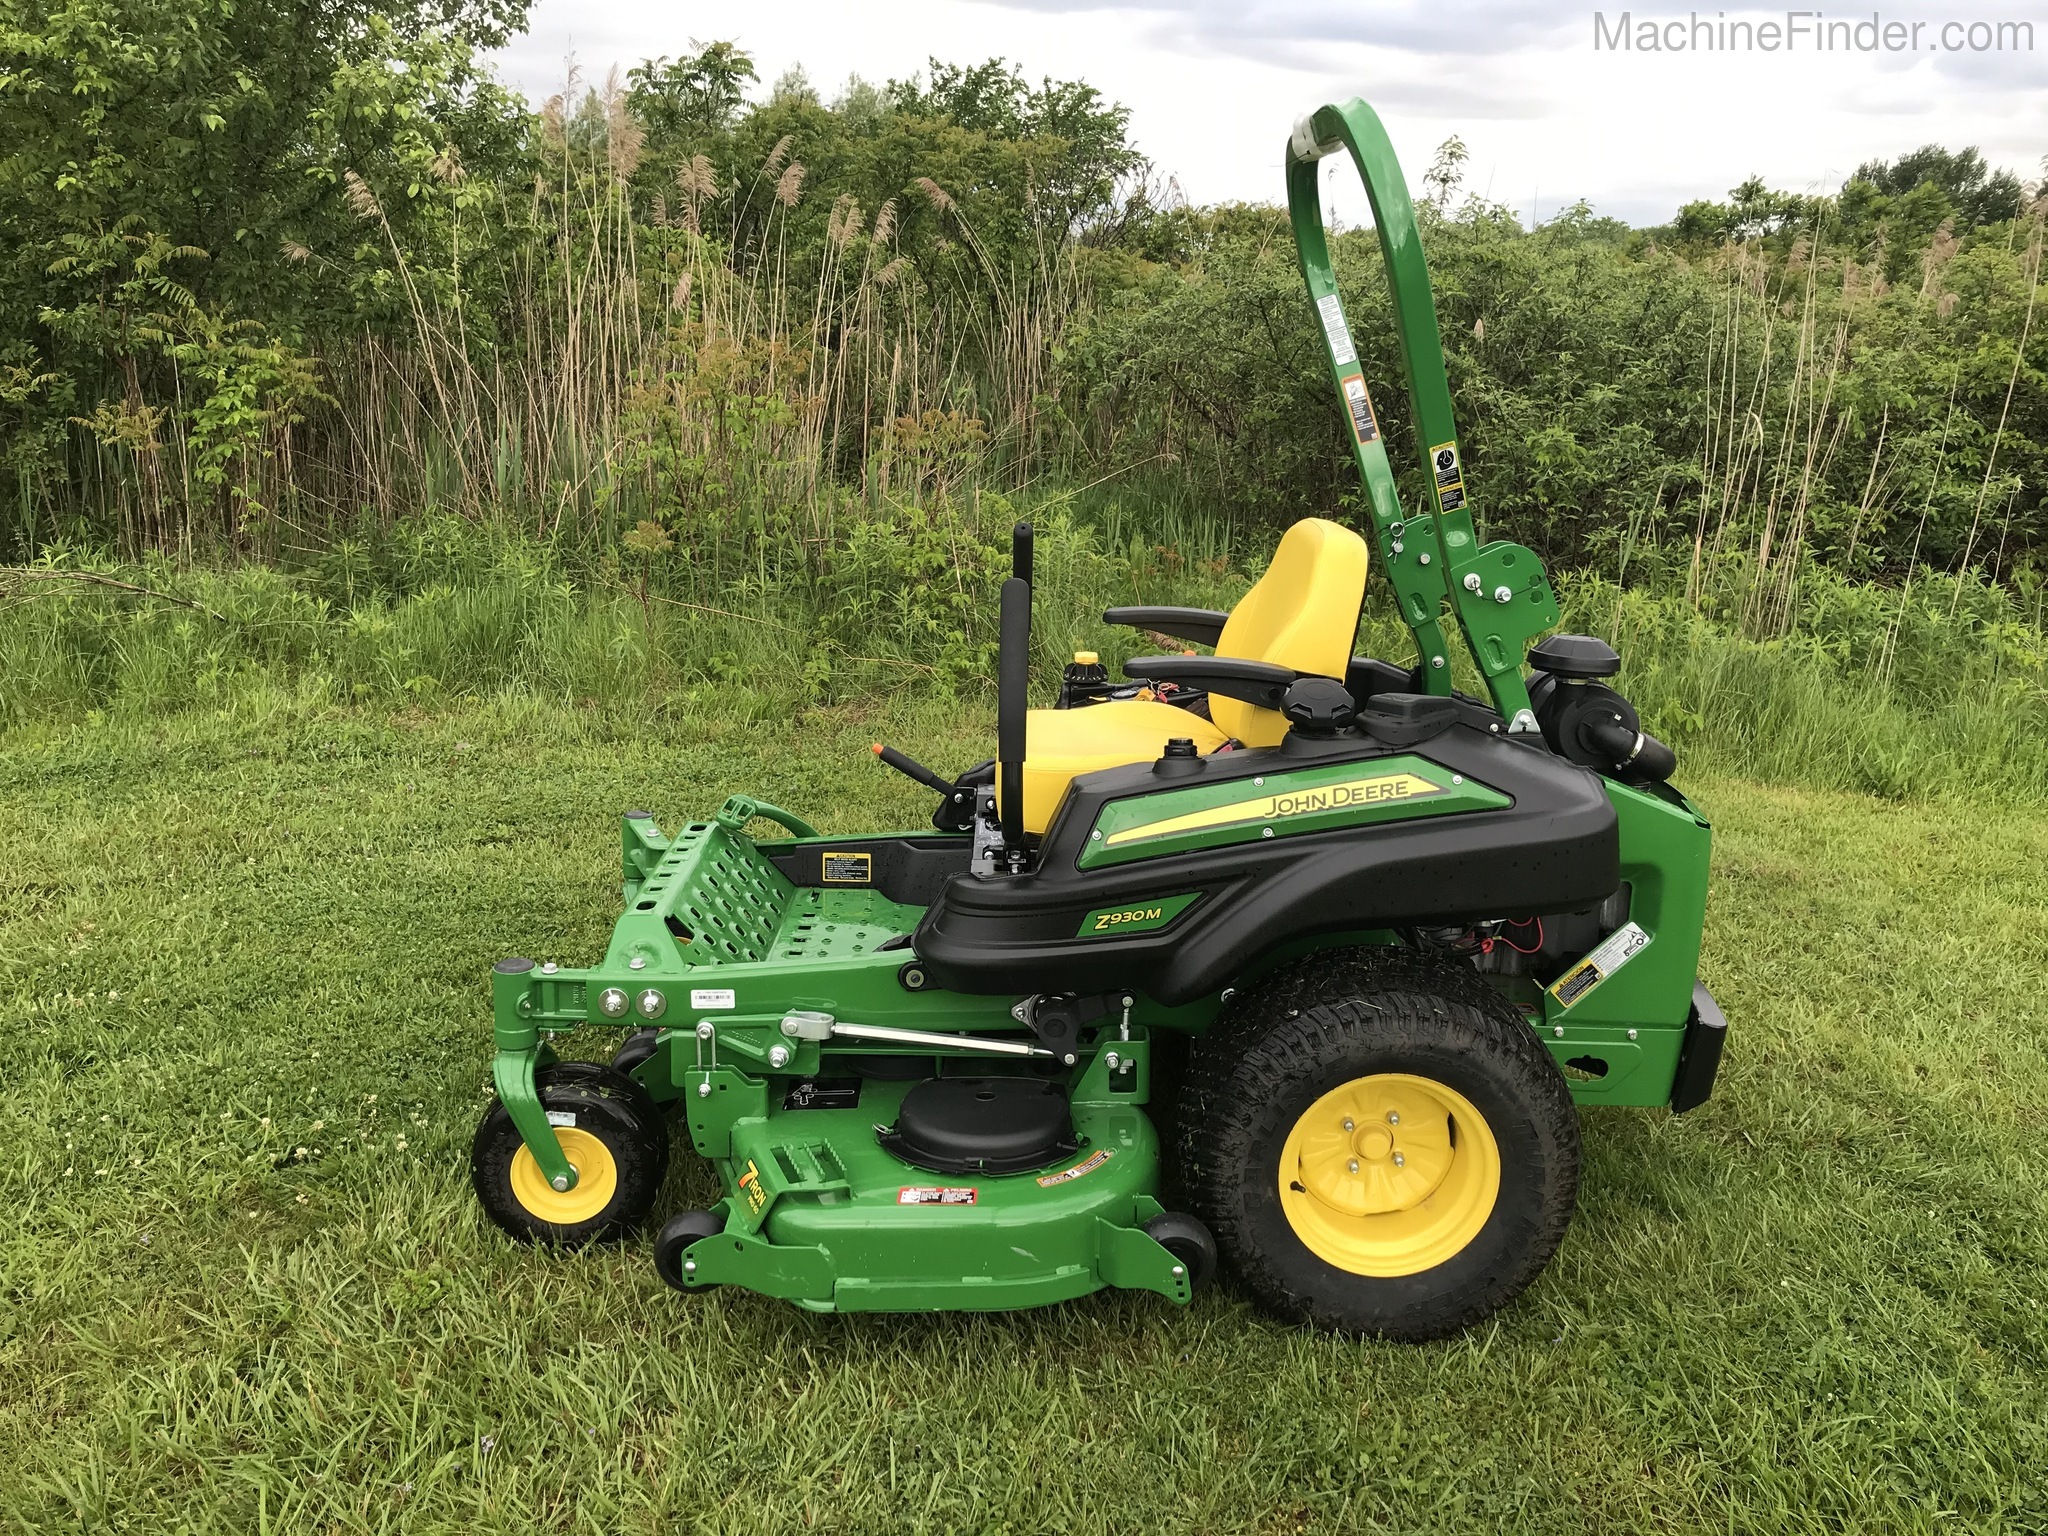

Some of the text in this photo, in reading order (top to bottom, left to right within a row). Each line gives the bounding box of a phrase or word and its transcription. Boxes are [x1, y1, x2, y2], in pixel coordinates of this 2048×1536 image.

[1264, 780, 1409, 816] JOHN DEERE
[1094, 907, 1162, 930] Z930M
